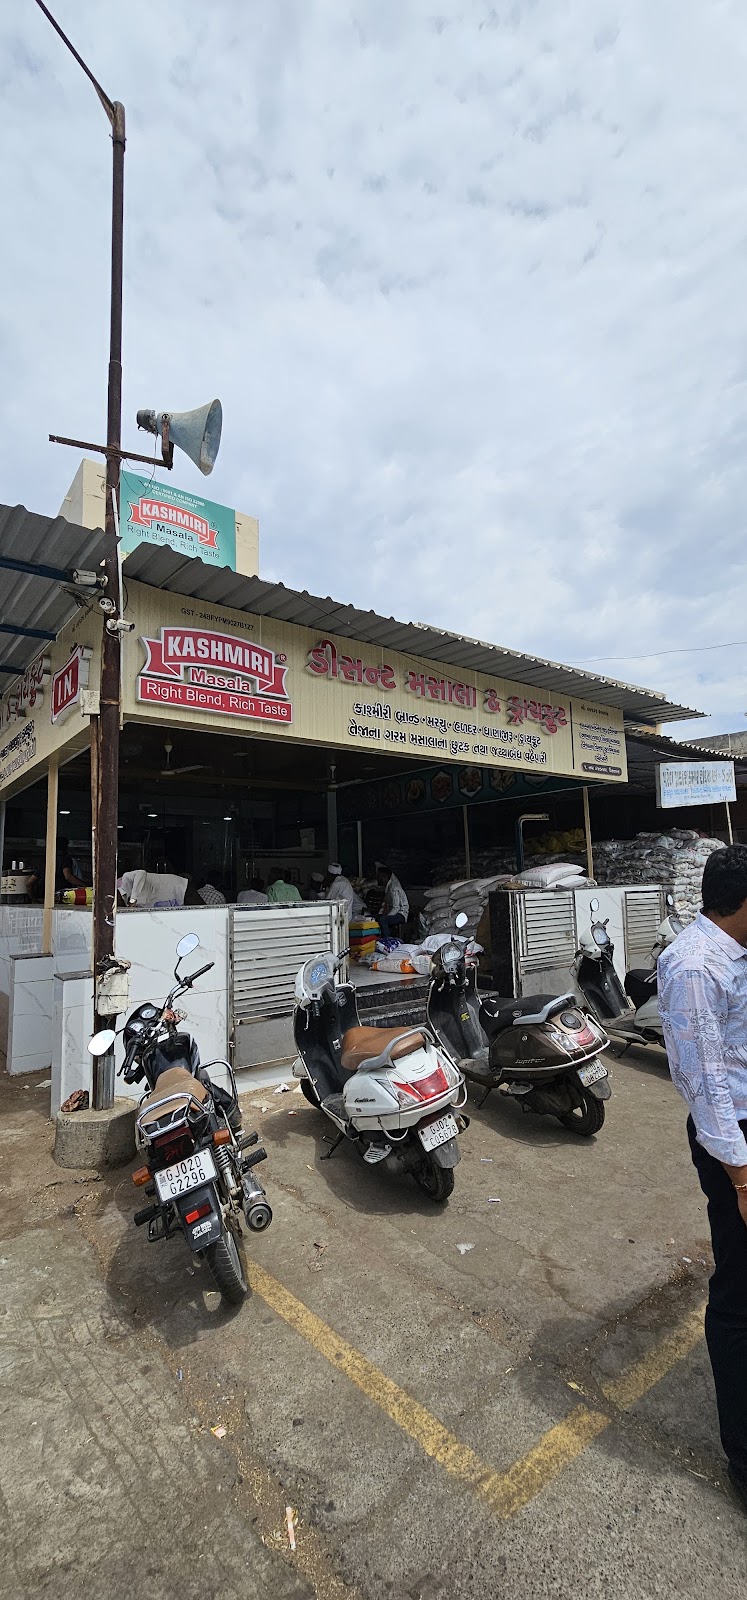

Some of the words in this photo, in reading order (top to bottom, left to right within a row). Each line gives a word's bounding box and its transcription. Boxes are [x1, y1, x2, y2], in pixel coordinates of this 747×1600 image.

[142, 502, 207, 535] KASHMIRI
[127, 524, 149, 538] Right
[152, 532, 177, 548] Blend,
[180, 540, 198, 553] Rich
[200, 546, 220, 559] Taste
[156, 523, 194, 542] Masala
[181, 607, 195, 617] GST
[168, 635, 270, 677] KASHMIRI
[190, 667, 251, 692] Masala
[307, 639, 397, 690] ડીસન્ટ
[407, 671, 477, 708] મસાલા
[485, 688, 501, 713] &
[146, 682, 182, 699] Right
[186, 689, 225, 708] Blend,
[229, 696, 255, 711] Rich
[259, 701, 288, 717] Taste
[354, 702, 391, 719] કાશ્મીરી
[349, 719, 381, 739] તેજાના
[385, 730, 407, 743] ગરમ
[410, 733, 448, 750] મસાલાના
[472, 744, 488, 756] તથા
[430, 1117, 450, 1134] GJ02
[166, 1155, 201, 1181] GJ02D
[170, 1168, 206, 1194] G2296
